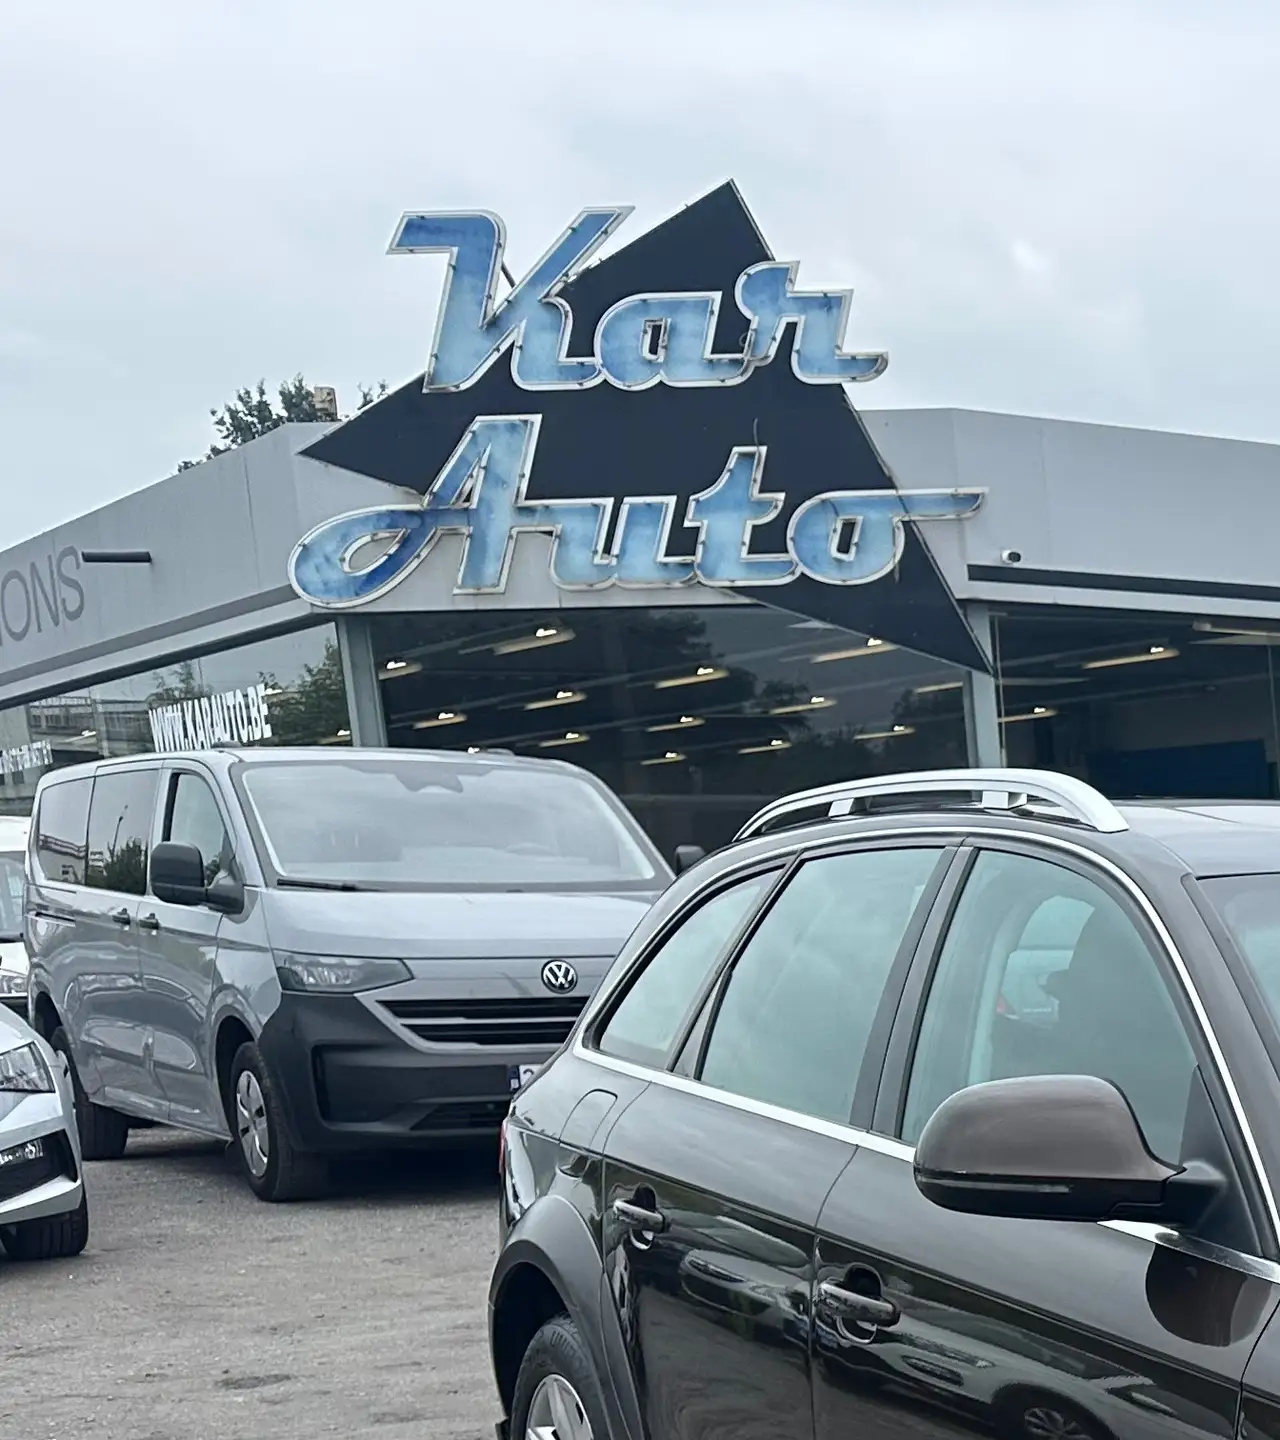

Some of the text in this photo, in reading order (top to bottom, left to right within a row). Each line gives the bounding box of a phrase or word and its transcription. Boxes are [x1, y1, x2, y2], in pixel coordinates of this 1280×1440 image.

[386, 205, 890, 392] Kar
[286, 413, 990, 609] Auto
[0, 545, 84, 646] ONS
[149, 683, 272, 752] WWW.KARAUTO.BE
